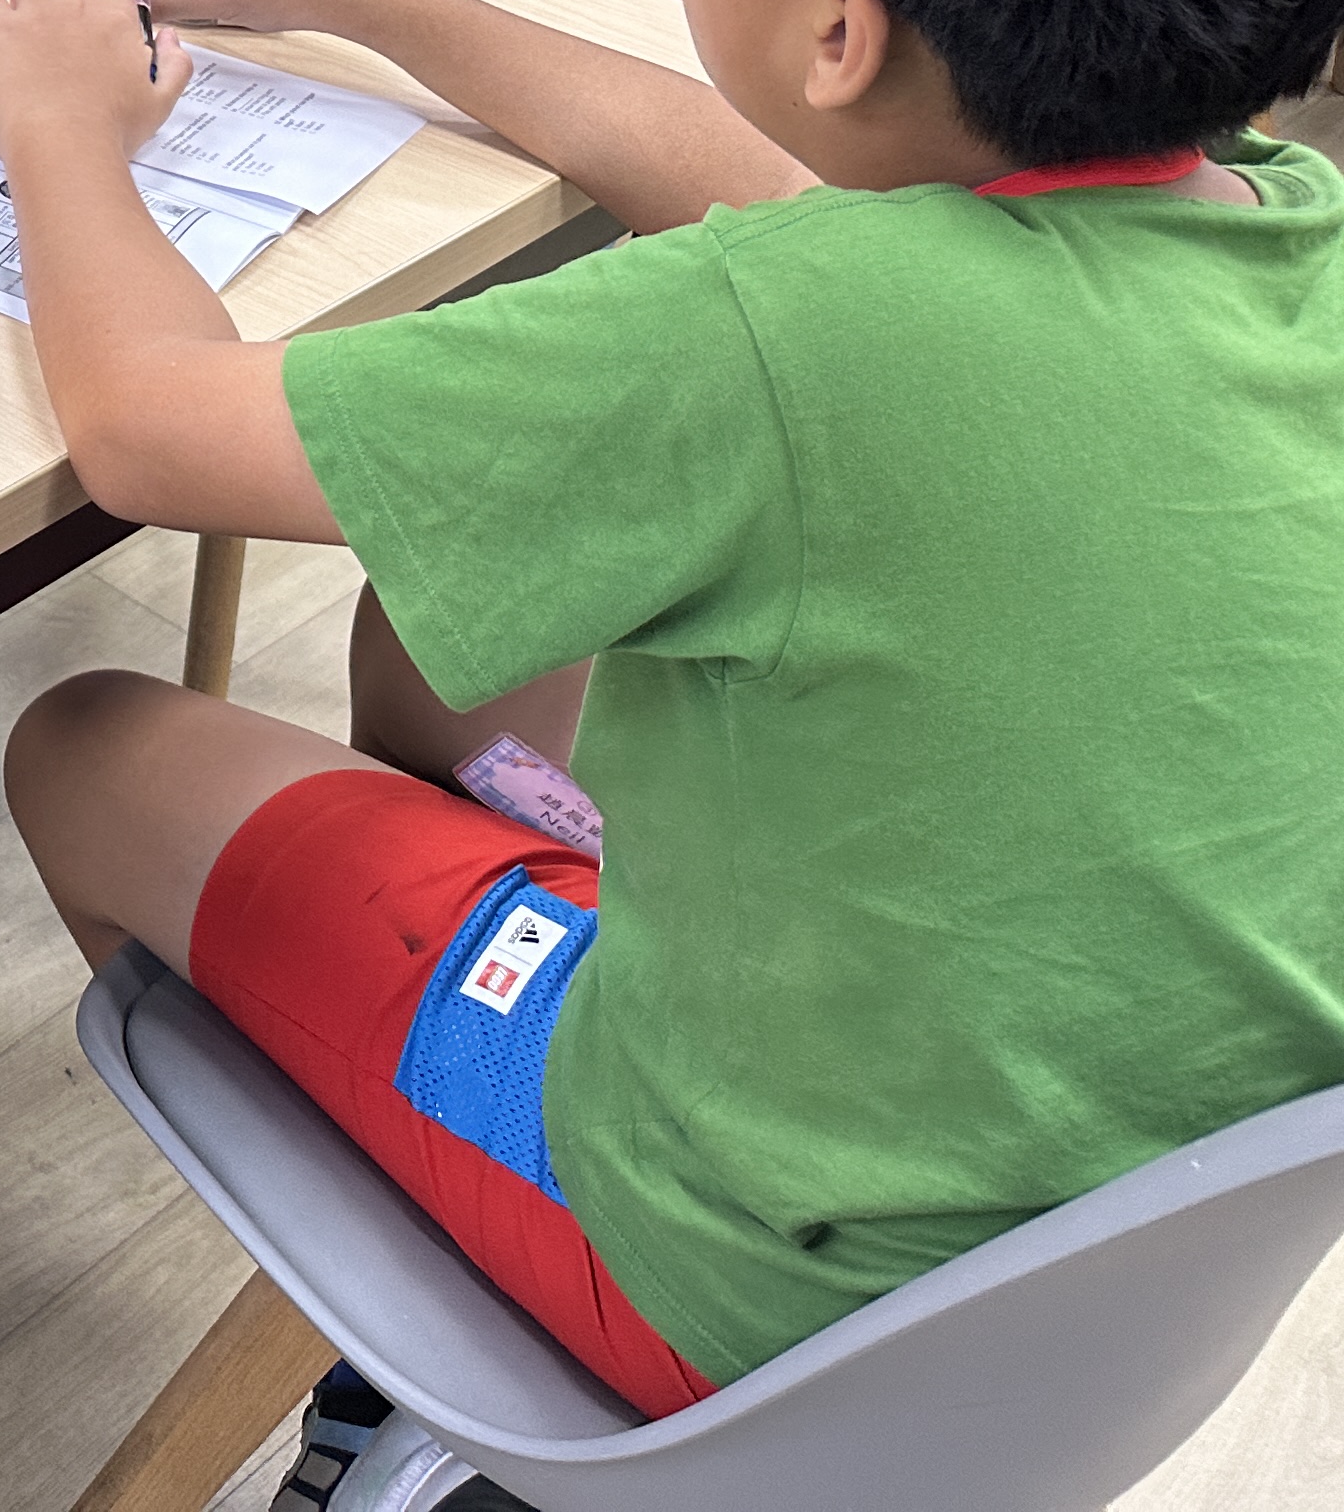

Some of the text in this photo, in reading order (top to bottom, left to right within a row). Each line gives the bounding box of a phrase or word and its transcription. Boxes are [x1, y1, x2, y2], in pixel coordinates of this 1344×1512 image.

[539, 811, 586, 845] Neil
[507, 916, 533, 945] adidas
[487, 965, 509, 991] LEGO
